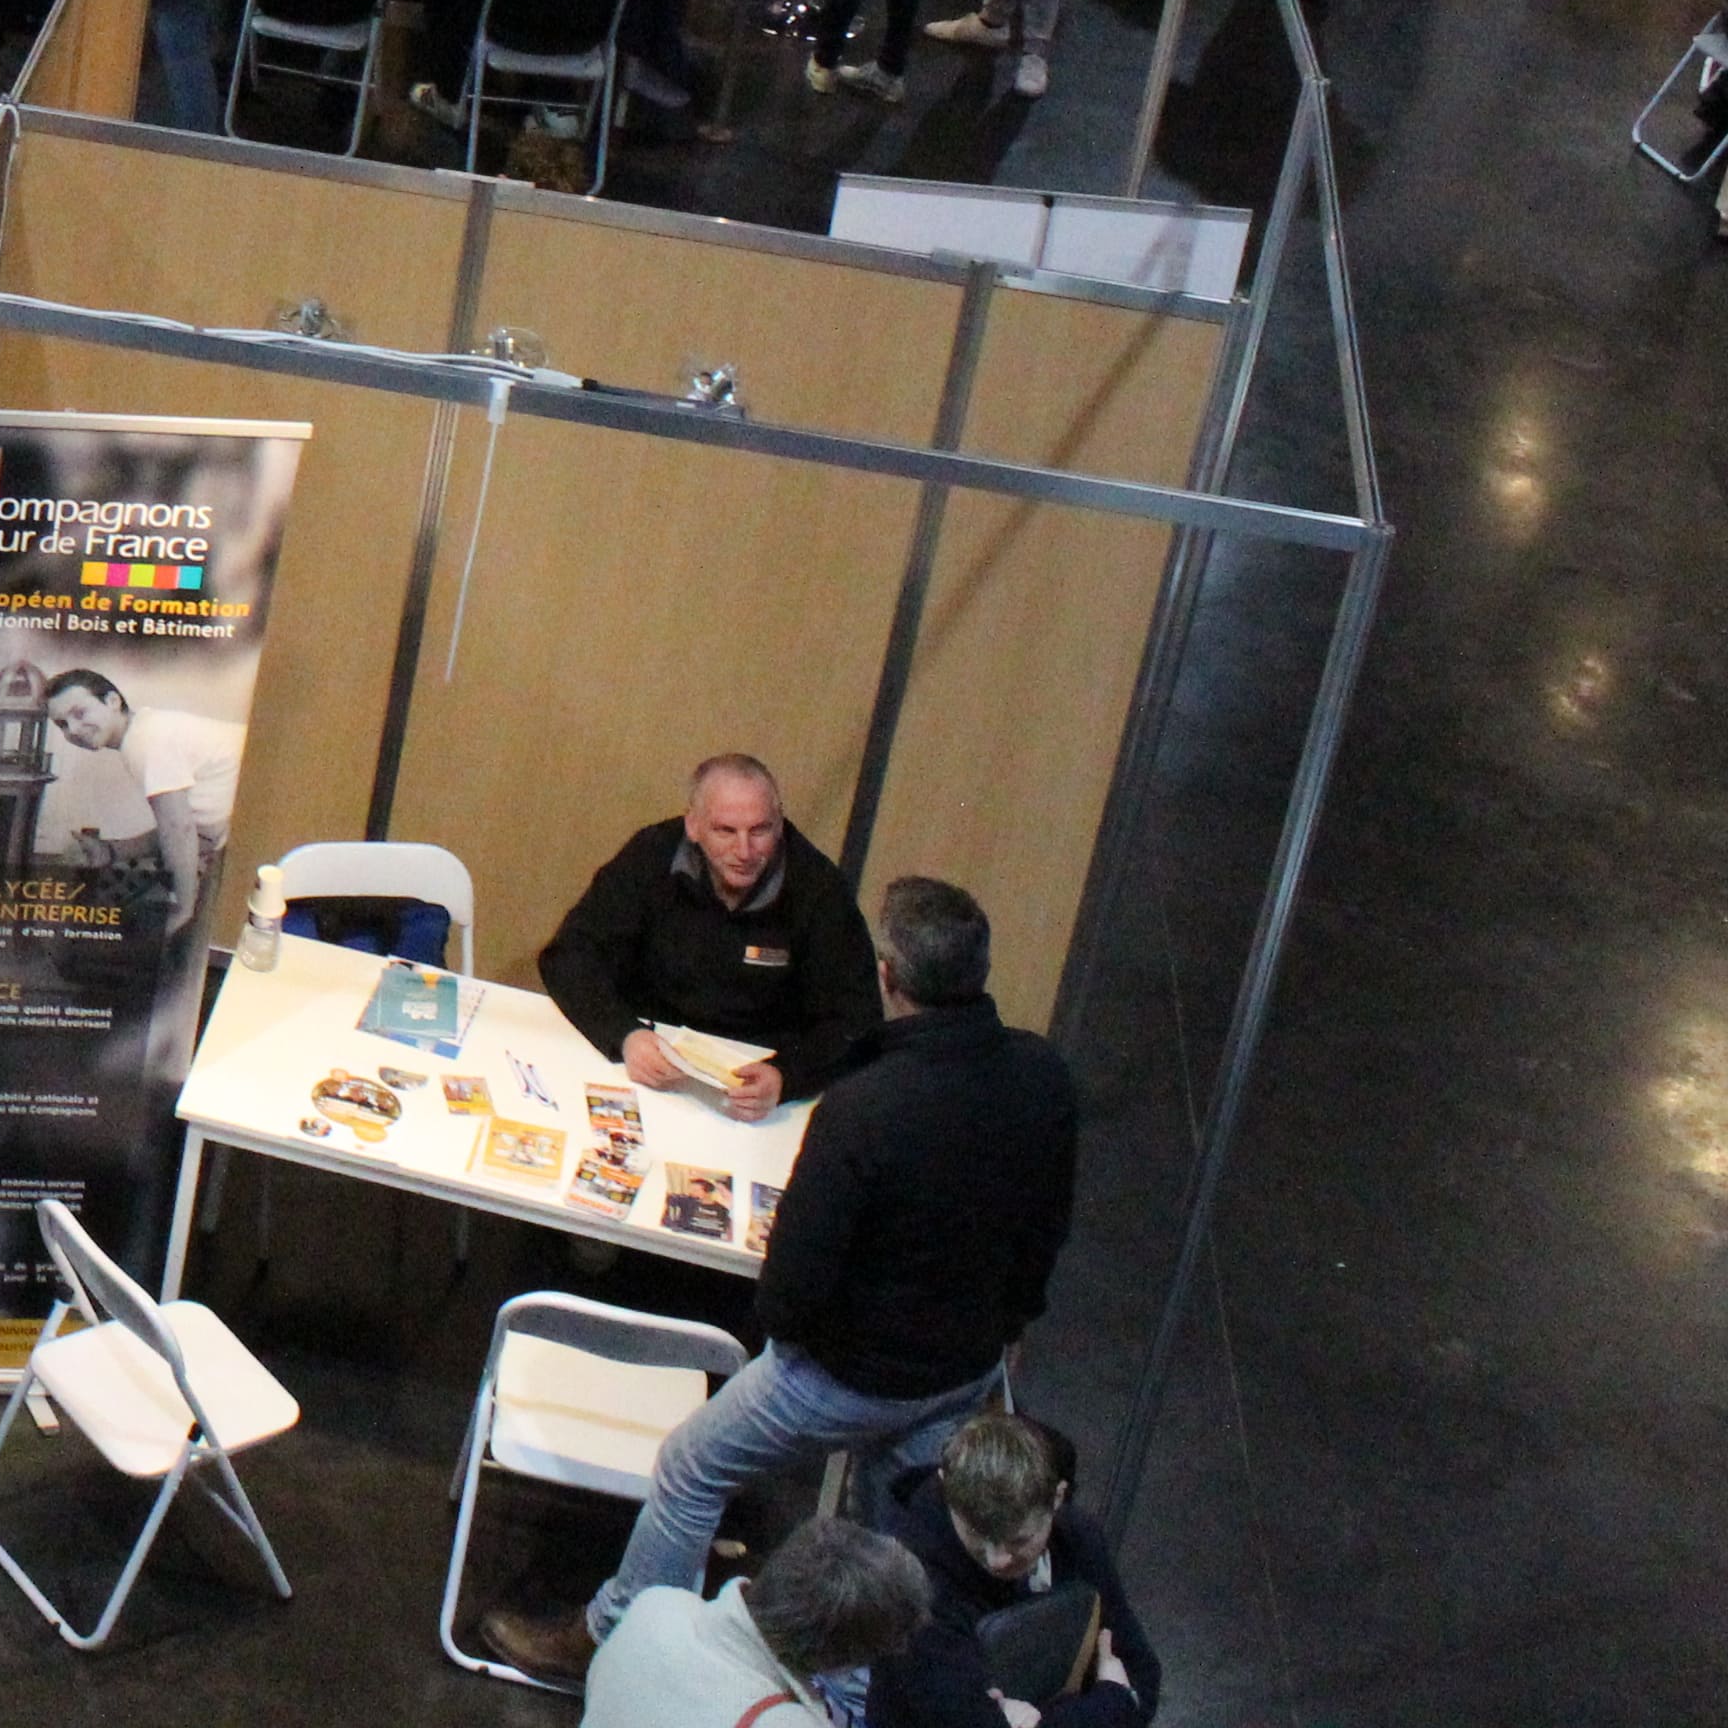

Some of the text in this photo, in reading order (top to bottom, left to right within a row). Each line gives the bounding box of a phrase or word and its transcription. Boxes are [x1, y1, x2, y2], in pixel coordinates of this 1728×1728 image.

[39, 531, 76, 555] de
[85, 527, 209, 561] France
[80, 590, 112, 612] de
[119, 593, 250, 617] Formation
[67, 614, 110, 634] Bois
[115, 618, 137, 635] et
[142, 616, 236, 639] Bâtiment
[21, 927, 55, 939] d'une
[63, 928, 123, 942] formation
[23, 1005, 61, 1018] qualité
